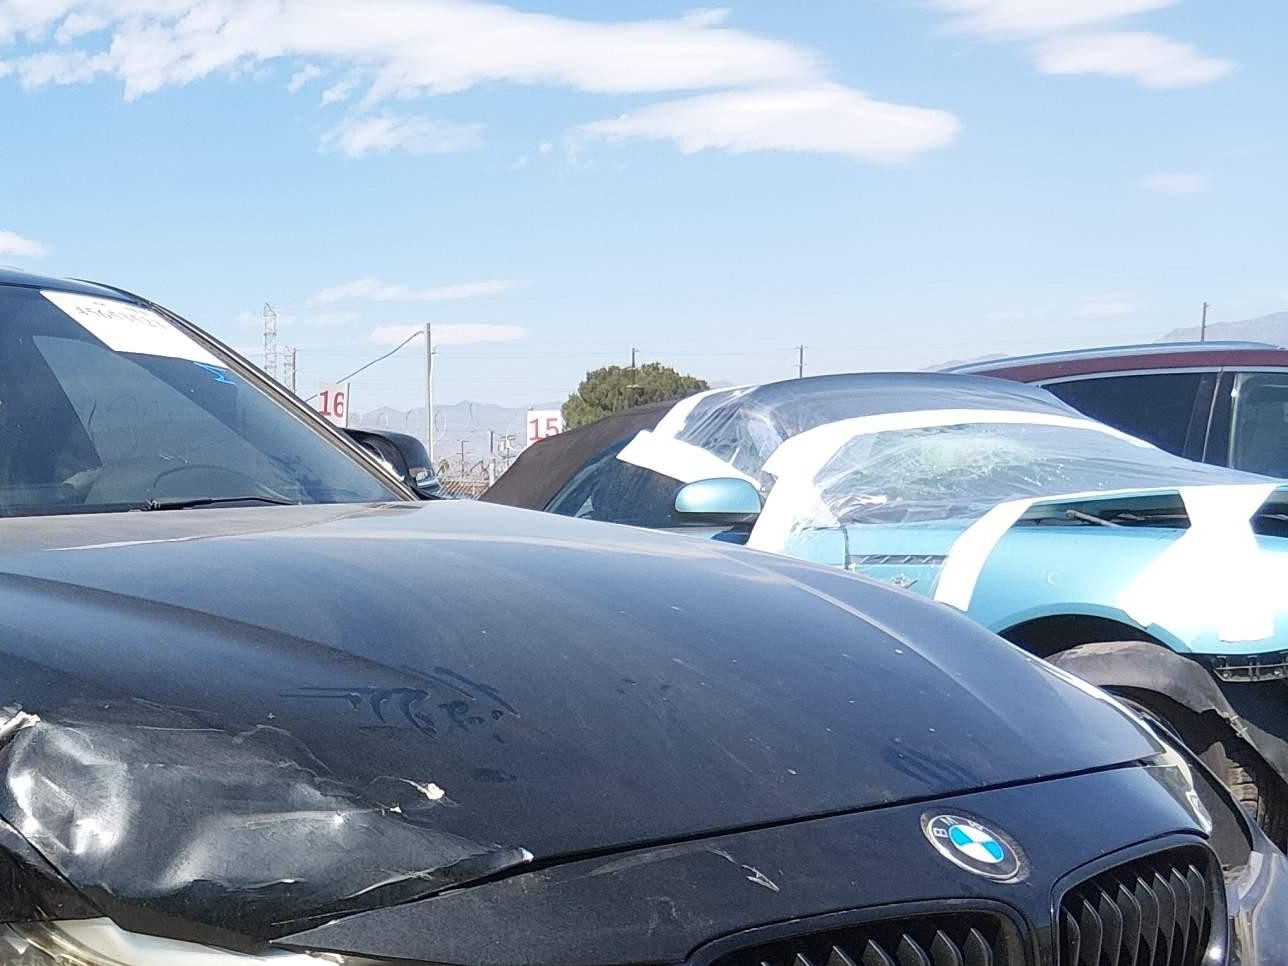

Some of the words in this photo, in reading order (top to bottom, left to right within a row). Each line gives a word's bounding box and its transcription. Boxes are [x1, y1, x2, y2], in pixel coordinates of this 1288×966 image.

[319, 391, 345, 418] 16
[529, 417, 560, 441] 15
[932, 816, 984, 839] BMW
